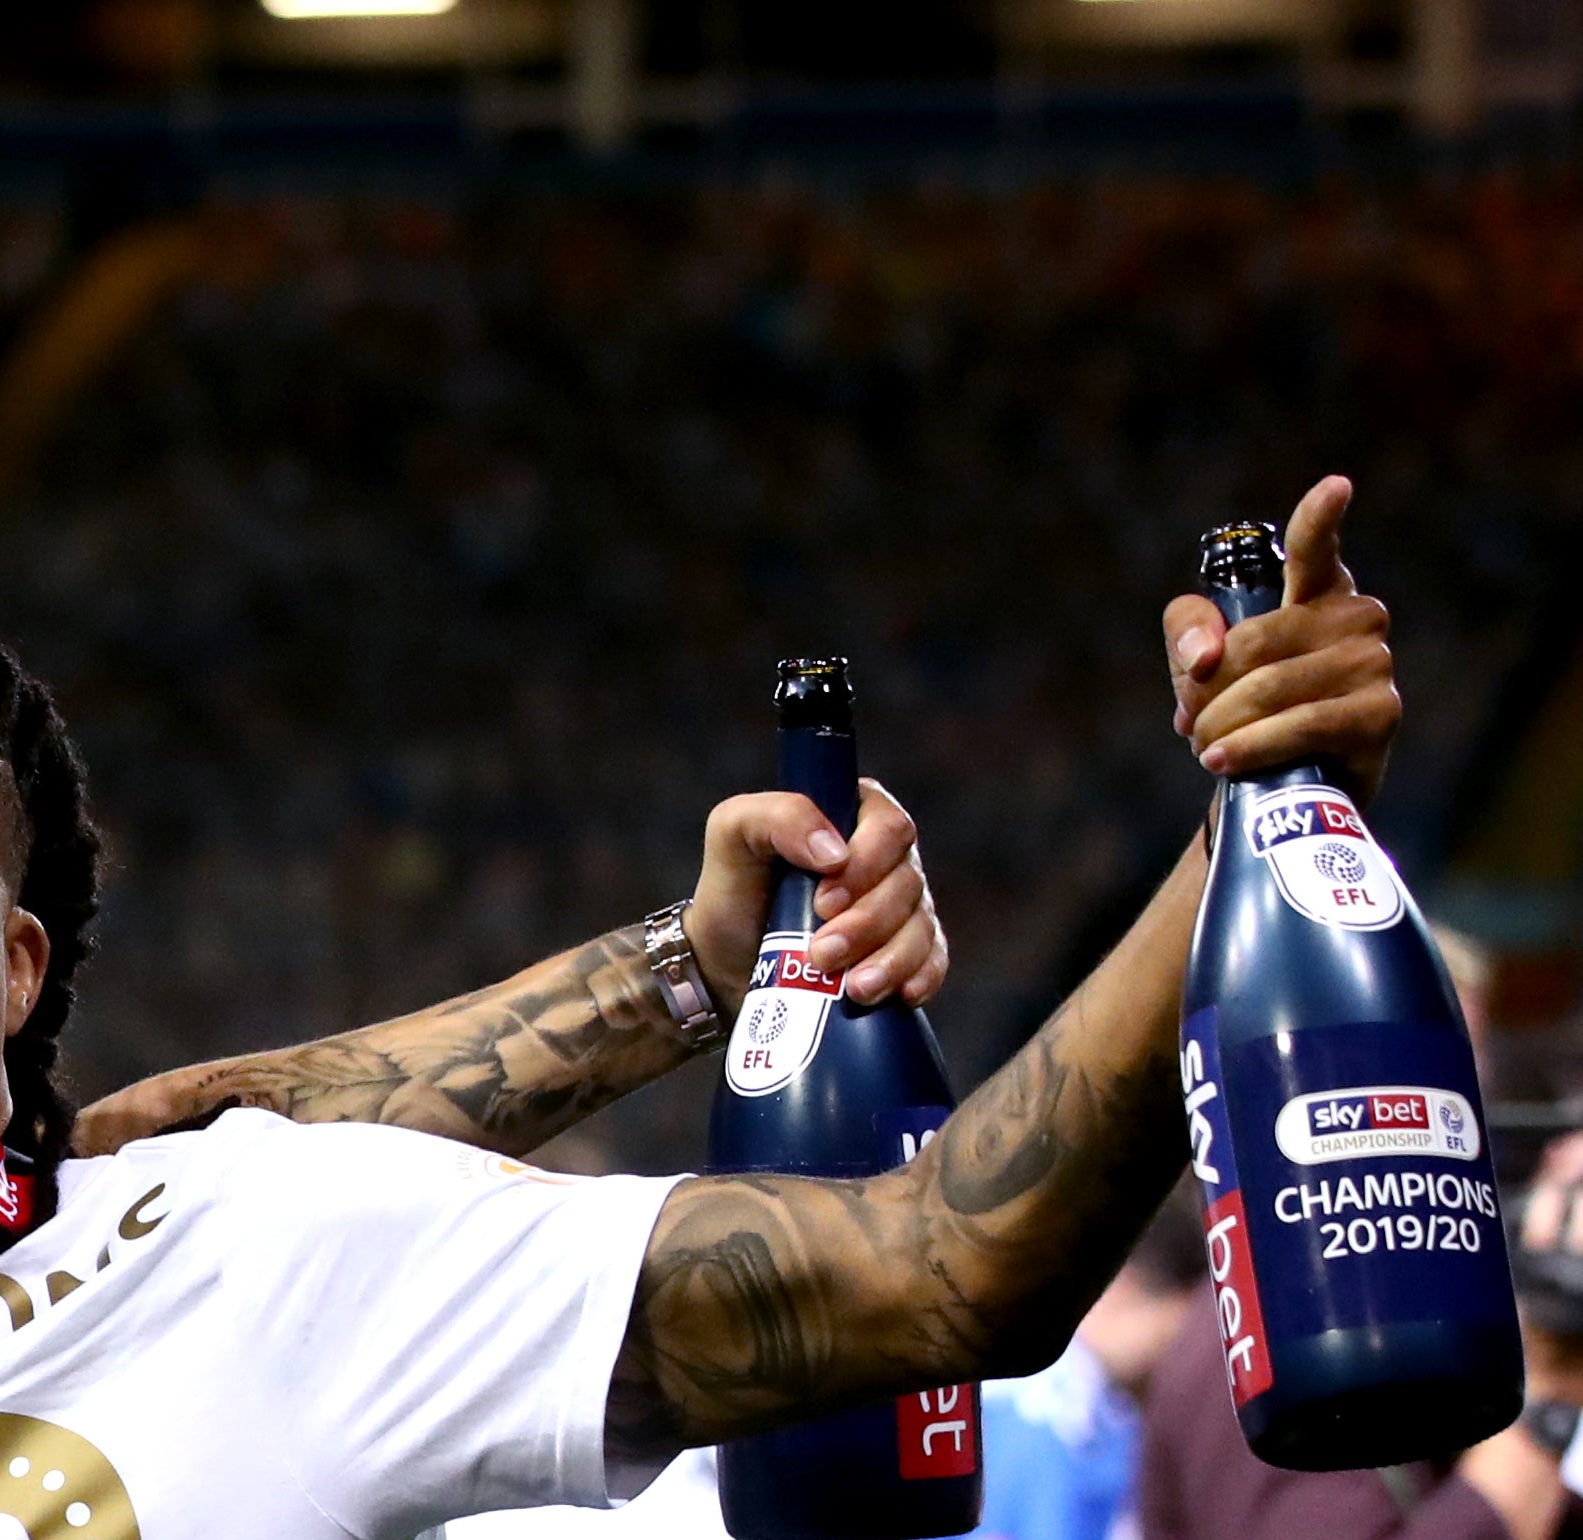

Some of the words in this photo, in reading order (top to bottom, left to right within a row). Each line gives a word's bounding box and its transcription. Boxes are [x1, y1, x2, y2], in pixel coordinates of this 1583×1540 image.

[1322, 803, 1362, 833] be
[1332, 888, 1376, 906] EFL
[750, 956, 777, 987] ky
[743, 1050, 773, 1069] EFL
[1314, 1100, 1364, 1130] sky
[1373, 1098, 1423, 1122] bet
[1311, 1132, 1432, 1156] CHAMPIONSHIP
[1445, 1135, 1468, 1153] EFL
[1180, 1039, 1220, 1184] sky
[1207, 1214, 1255, 1386] bet
[1274, 1171, 1497, 1223] CHAMPIONS
[1319, 1214, 1481, 1259] 2019/20
[918, 1384, 967, 1457] et
